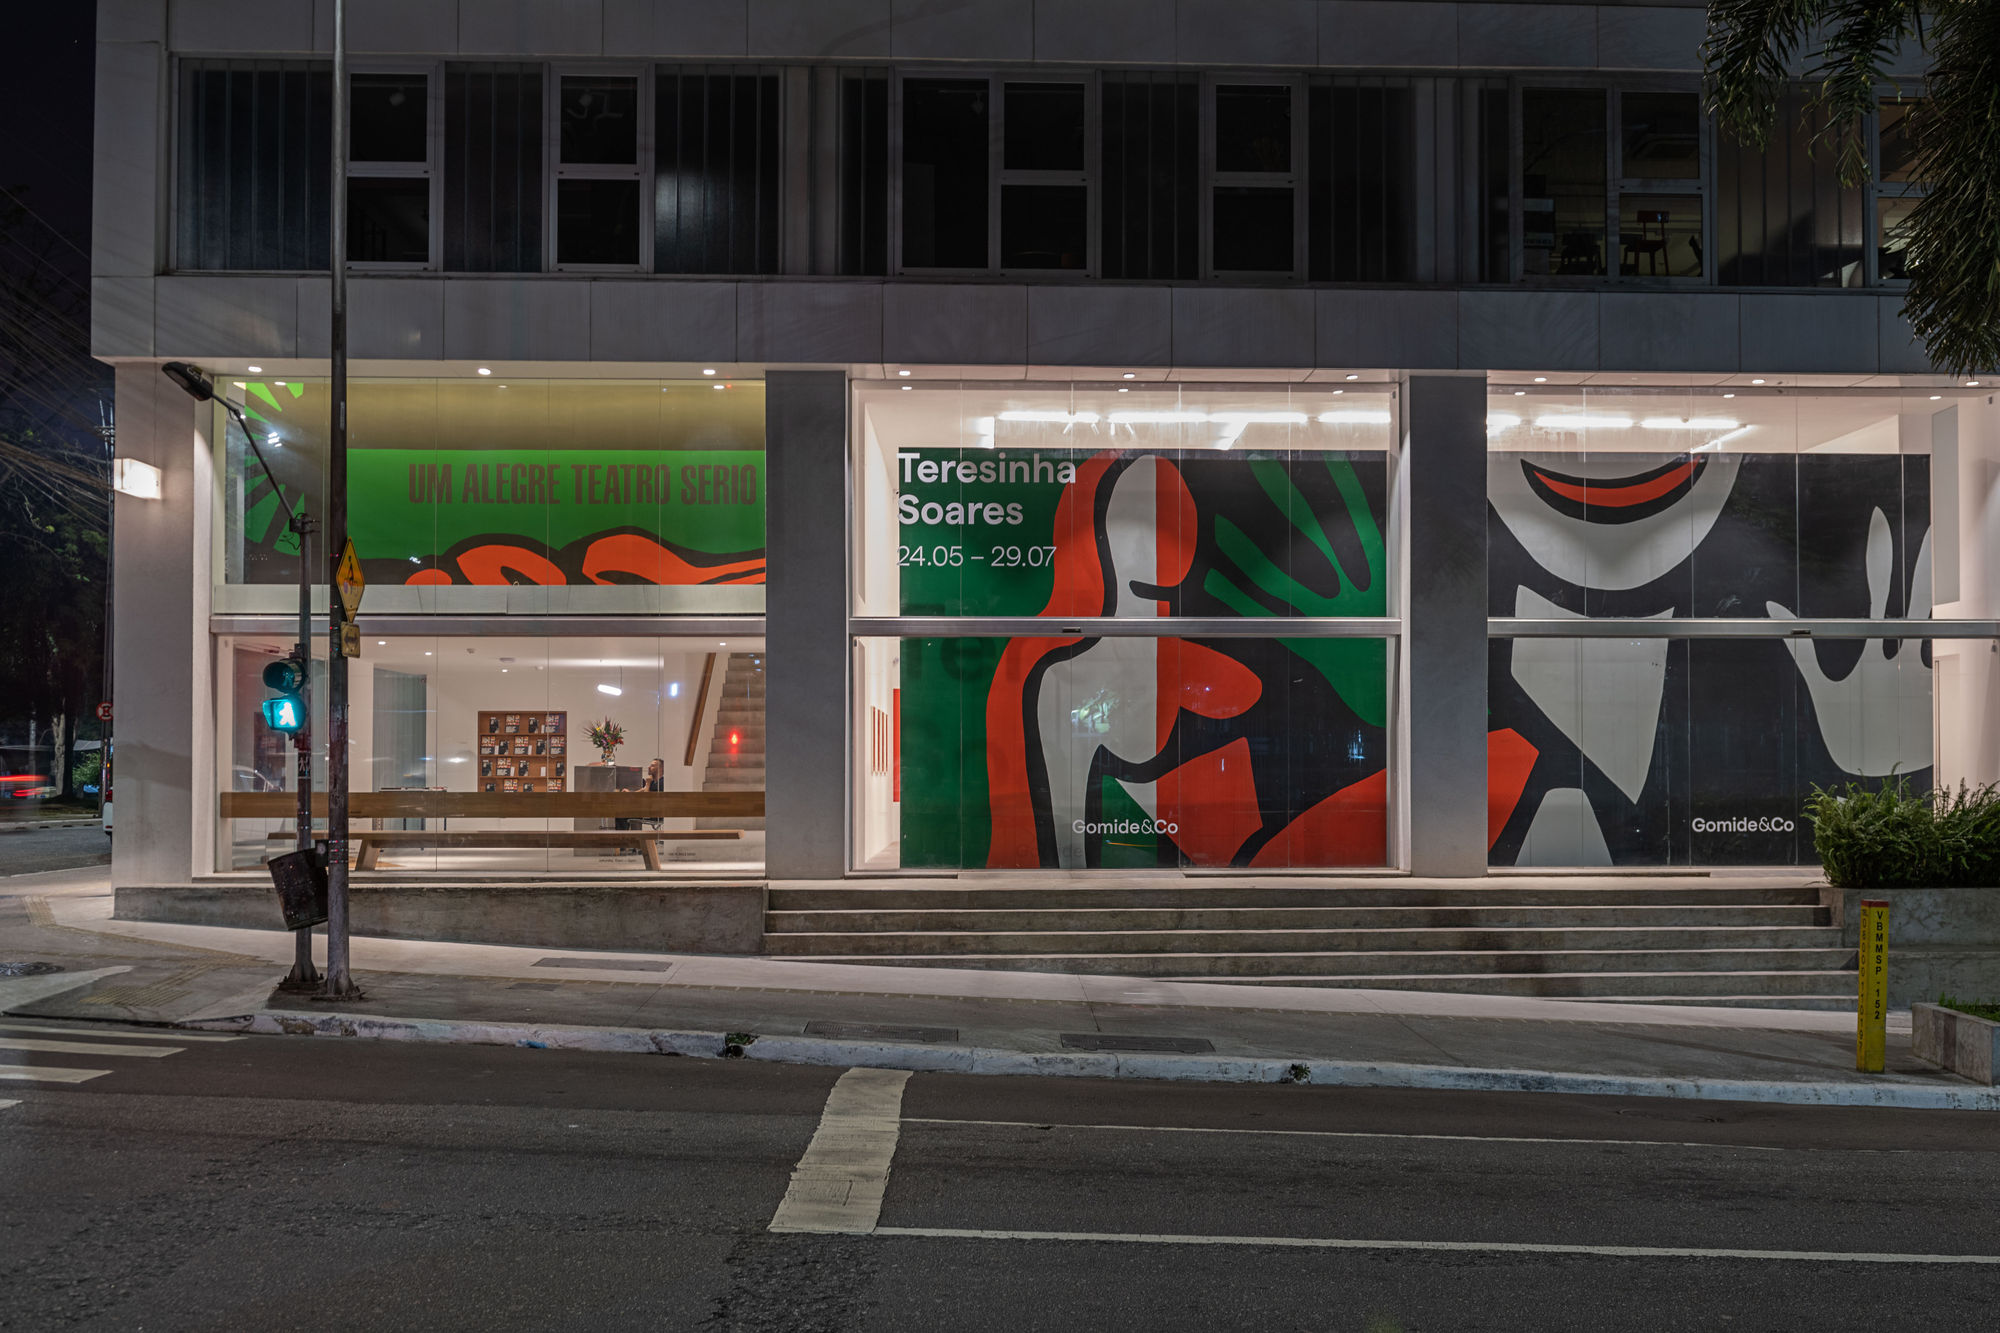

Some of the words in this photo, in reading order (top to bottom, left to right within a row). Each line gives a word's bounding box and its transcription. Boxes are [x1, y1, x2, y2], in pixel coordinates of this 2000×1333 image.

[896, 452, 1076, 484] Teresinha
[408, 463, 453, 504] UM
[462, 463, 561, 505] ALEGRE
[571, 464, 671, 505] TEATRO
[680, 464, 757, 505] SERIO
[898, 494, 1024, 525] Soares
[896, 545, 964, 567] 24.05
[990, 545, 1057, 567] 29.07
[1072, 818, 1179, 834] Gomide&Co
[1692, 816, 1795, 832] Gomide&Co
